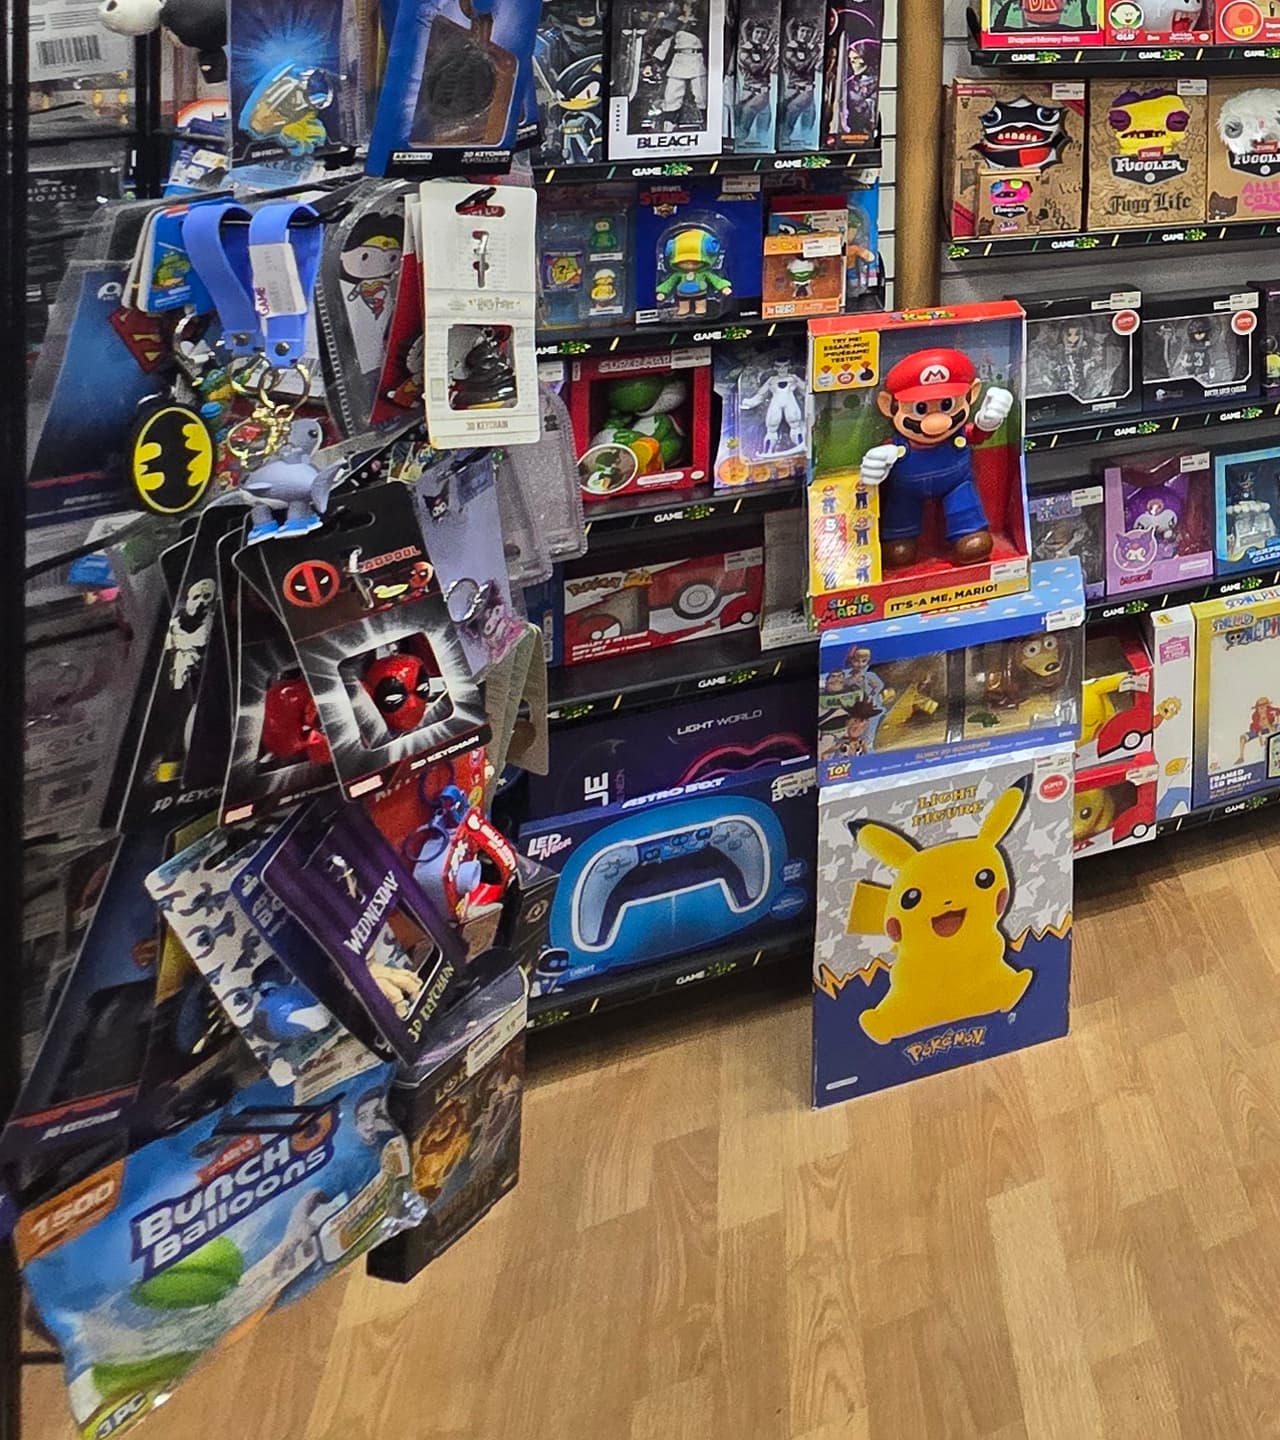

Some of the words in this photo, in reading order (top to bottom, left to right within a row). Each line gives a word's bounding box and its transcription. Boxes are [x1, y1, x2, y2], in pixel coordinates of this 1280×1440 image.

[637, 135, 699, 150] BLEACH
[1154, 191, 1192, 210] Life
[954, 583, 998, 600] MARIO!
[676, 718, 714, 736] LIGHT
[716, 708, 762, 727] WORLD
[621, 782, 682, 810] ASTRO
[917, 784, 978, 811] LIGHT
[911, 800, 985, 829] FIGURE
[343, 871, 400, 957] WEDNESDAY
